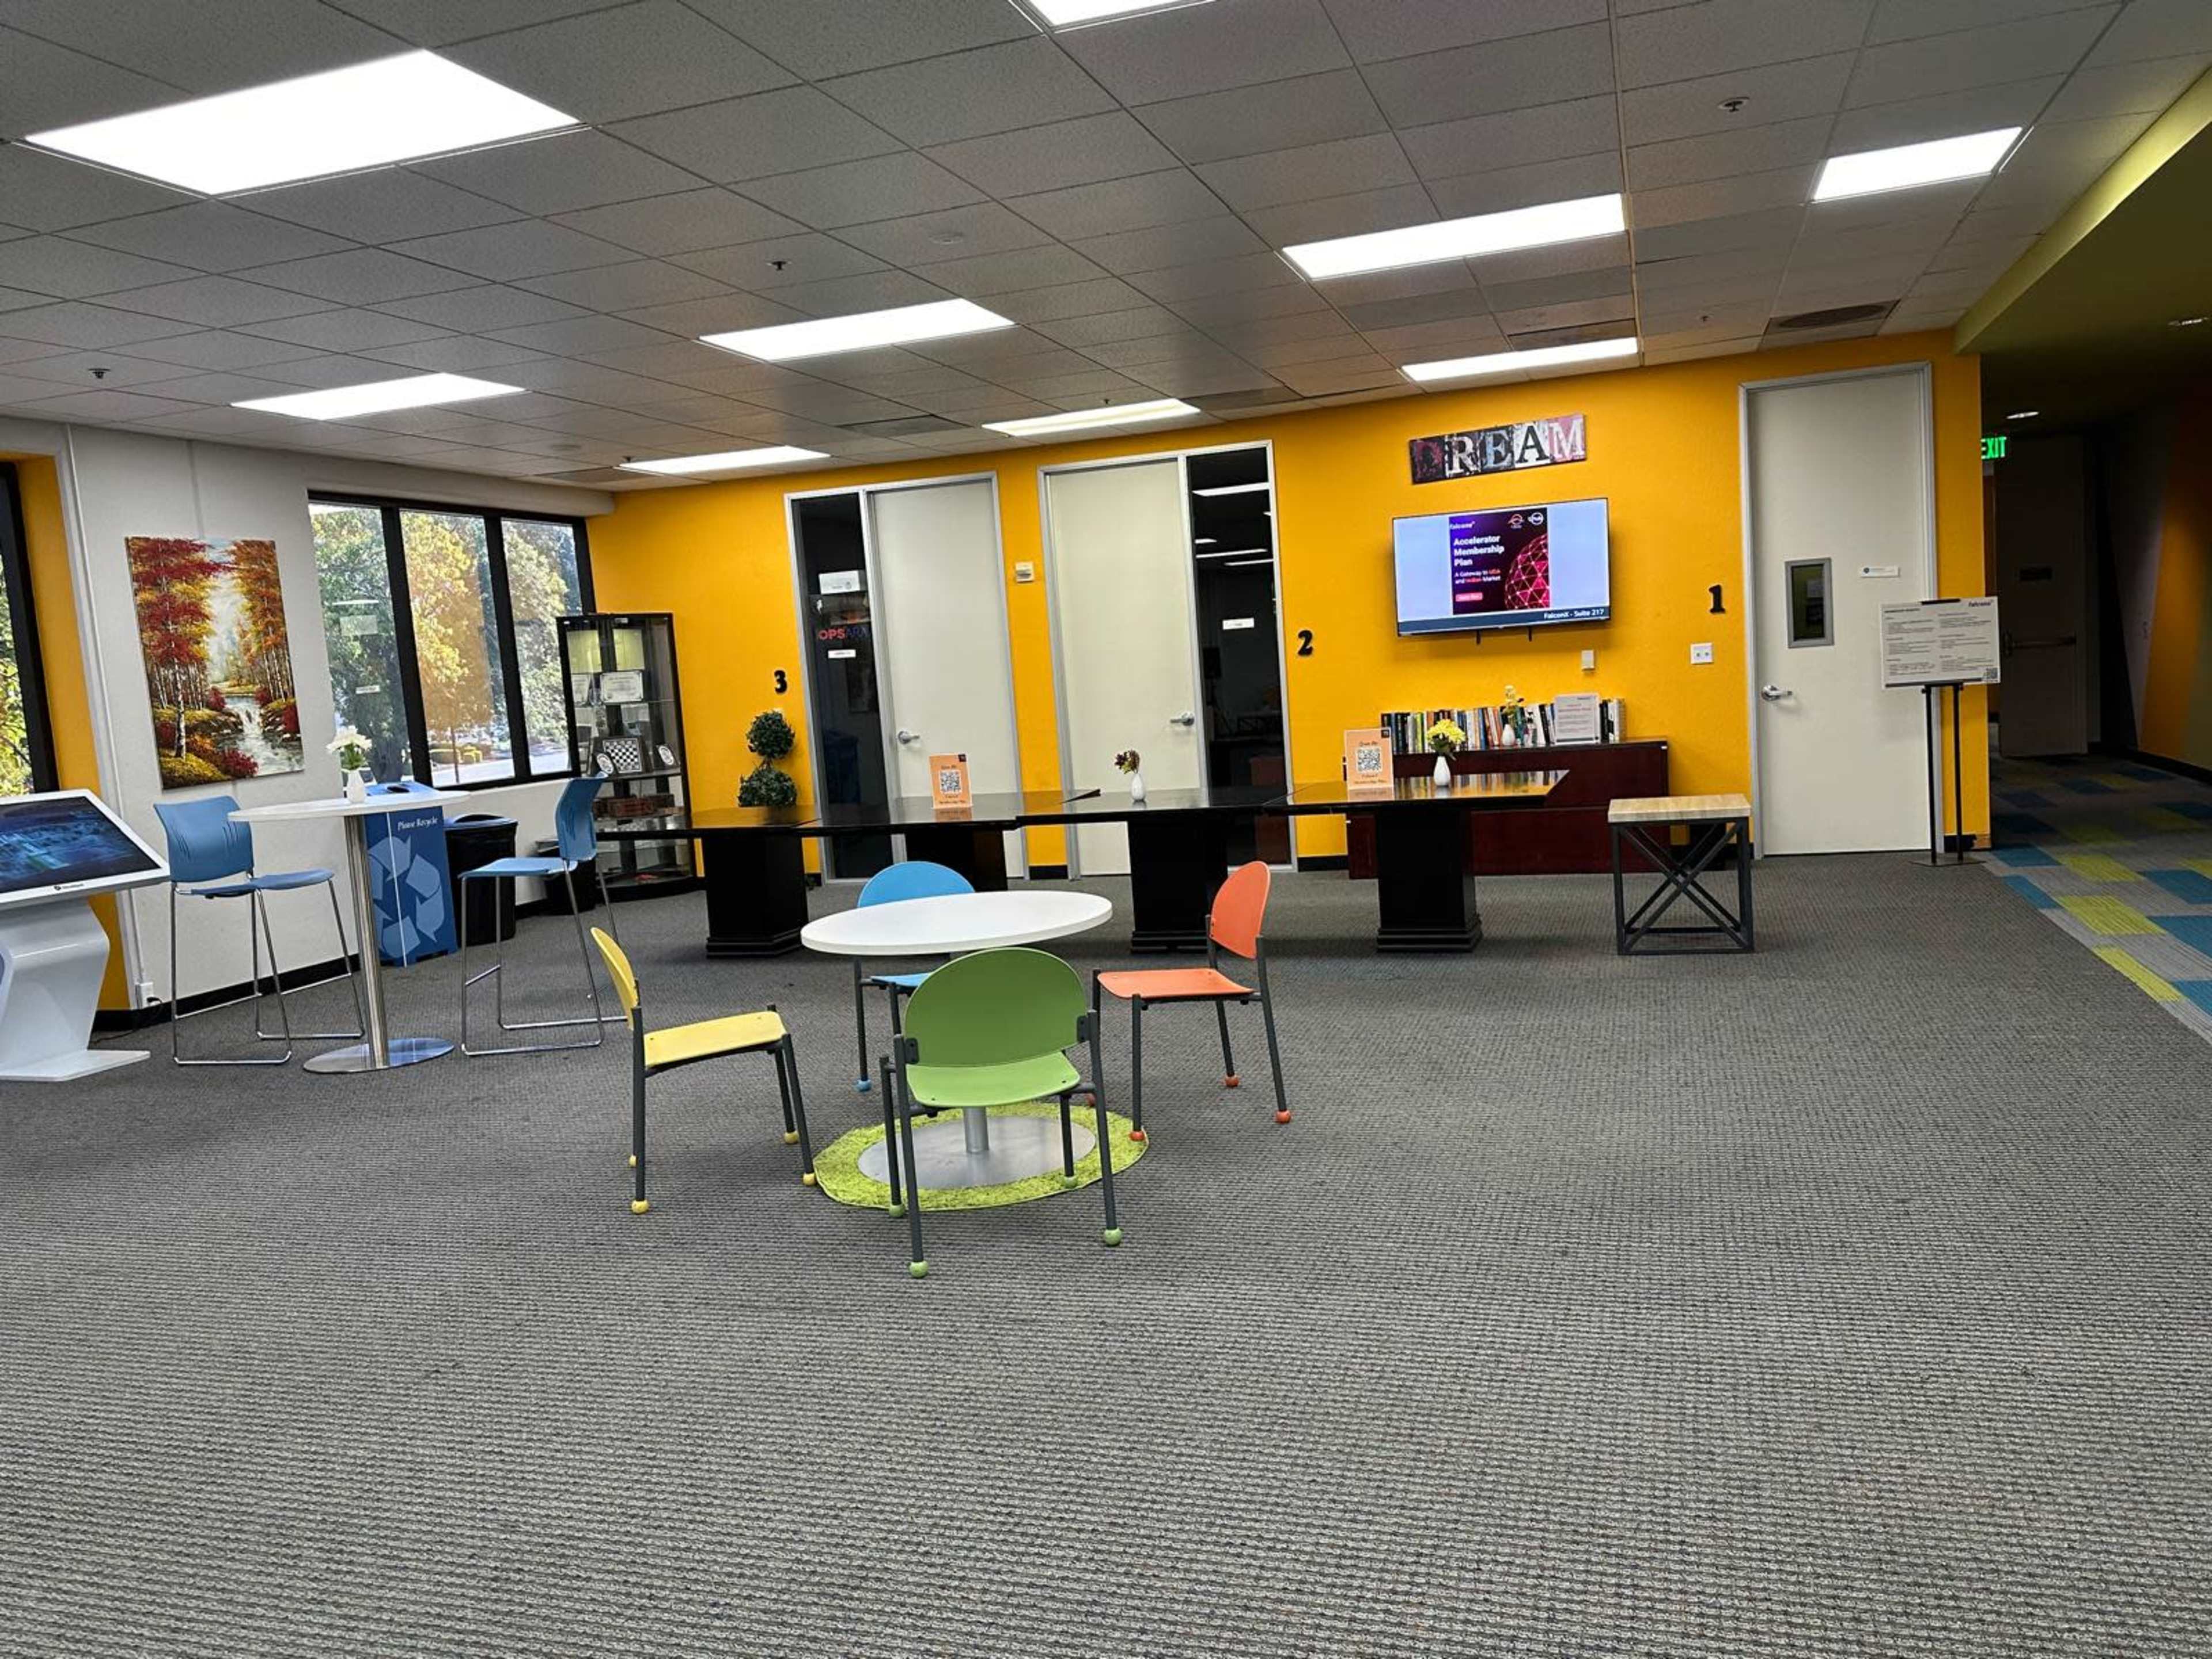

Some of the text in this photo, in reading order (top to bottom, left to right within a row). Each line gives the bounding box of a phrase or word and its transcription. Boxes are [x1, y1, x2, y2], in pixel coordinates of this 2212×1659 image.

[1416, 419, 1584, 477] DREAM
[1980, 436, 2007, 460] EXIT
[1454, 535, 1501, 546] Accelerator
[1454, 545, 1505, 556] Membership
[1454, 558, 1473, 566] Plan
[1709, 584, 1726, 614] 1
[1298, 630, 1313, 656] 2
[774, 670, 787, 694] 3
[397, 816, 438, 832] Please Recycle
